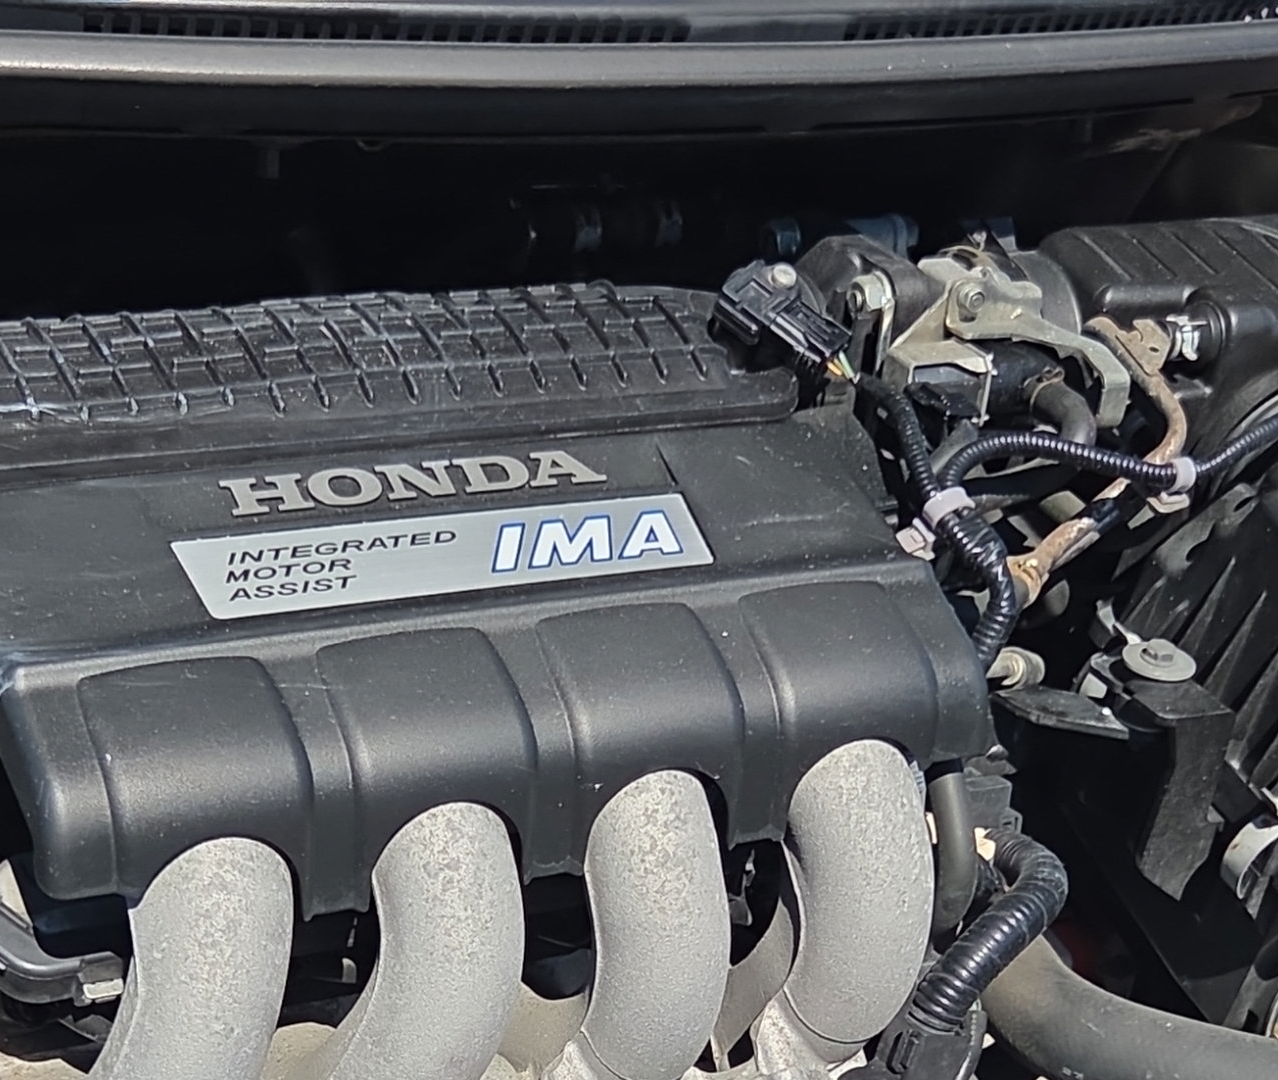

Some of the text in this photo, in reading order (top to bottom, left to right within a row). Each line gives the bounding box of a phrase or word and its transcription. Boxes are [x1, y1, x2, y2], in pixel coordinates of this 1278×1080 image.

[220, 450, 608, 516] HONDA
[227, 530, 457, 566] INTEGRATED
[490, 509, 684, 574] IMA
[225, 557, 353, 585] MOTOR
[228, 574, 358, 602] ASSIST
